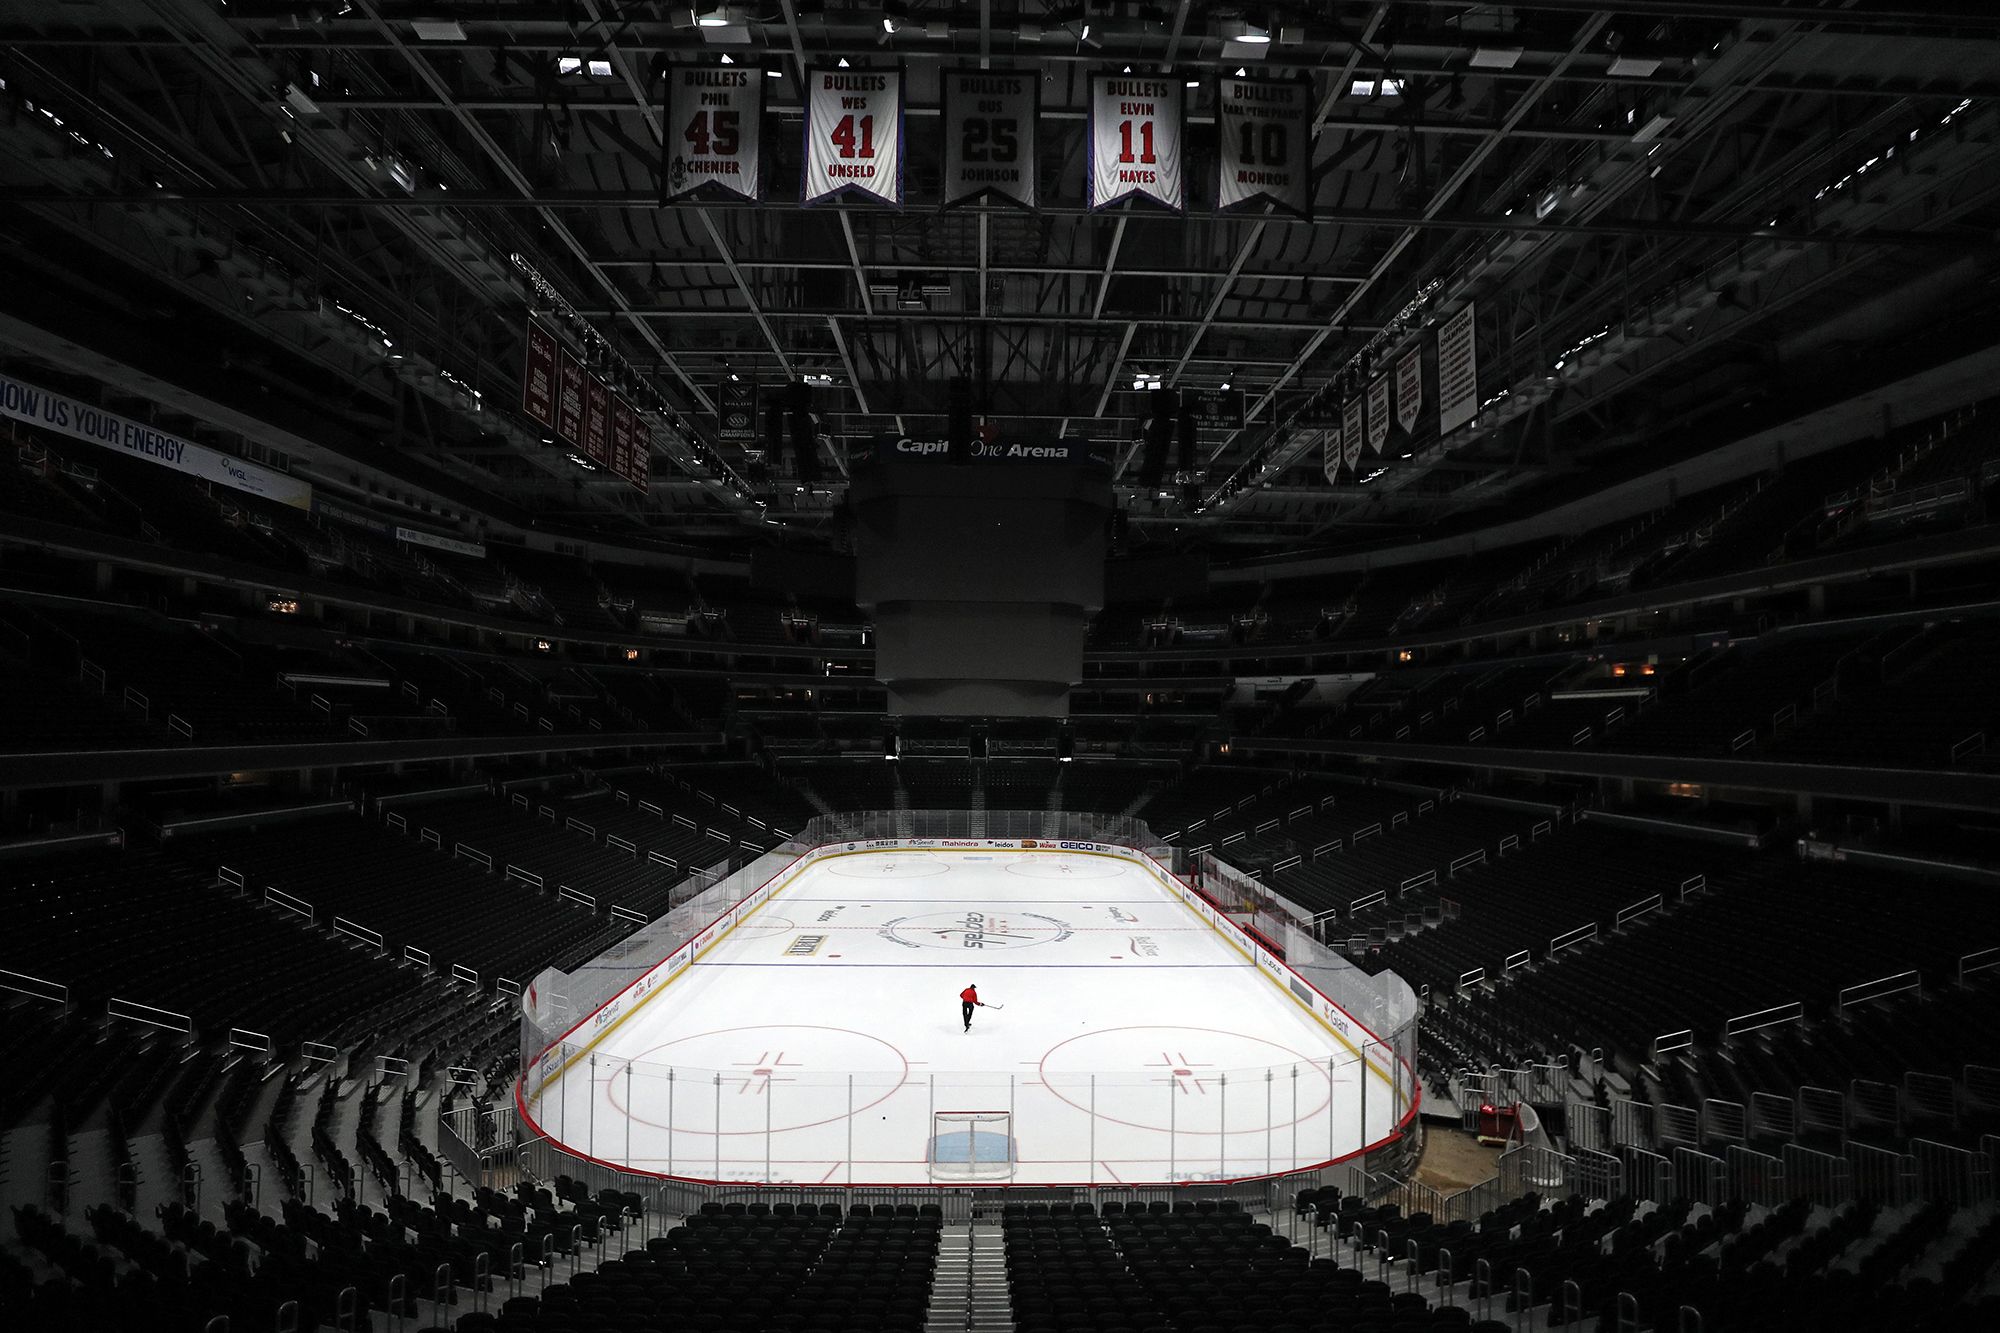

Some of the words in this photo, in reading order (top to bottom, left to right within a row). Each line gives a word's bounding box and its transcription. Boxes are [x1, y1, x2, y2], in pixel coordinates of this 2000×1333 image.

[685, 72, 747, 86] BULLETS
[824, 75, 885, 91] BULLETS
[959, 78, 1021, 94] BULLETS
[1107, 81, 1167, 97] BULLETS
[1234, 84, 1293, 102] BULLETS
[701, 93, 729, 106] PHIL
[841, 97, 866, 109] WES
[1121, 102, 1154, 115] ELVIN
[685, 111, 739, 155] 45
[831, 115, 874, 158] 41
[962, 118, 1017, 162] 25
[1119, 120, 1156, 164] 11
[1240, 121, 1287, 166] 10
[687, 161, 739, 174] CHENIER
[829, 165, 875, 178] UNSELD
[961, 168, 1019, 182] JOHNSON
[1120, 171, 1156, 184] HAYES
[1238, 170, 1289, 185] MONROE
[44, 395, 69, 427] US
[73, 404, 119, 445] YOUR
[124, 424, 184, 464] ENERGY
[896, 438, 949, 455] Capit
[1007, 443, 1068, 458] Arena
[228, 466, 247, 481] WGL
[1060, 841, 1094, 851] GEICO
[1330, 1009, 1349, 1037] Giant
